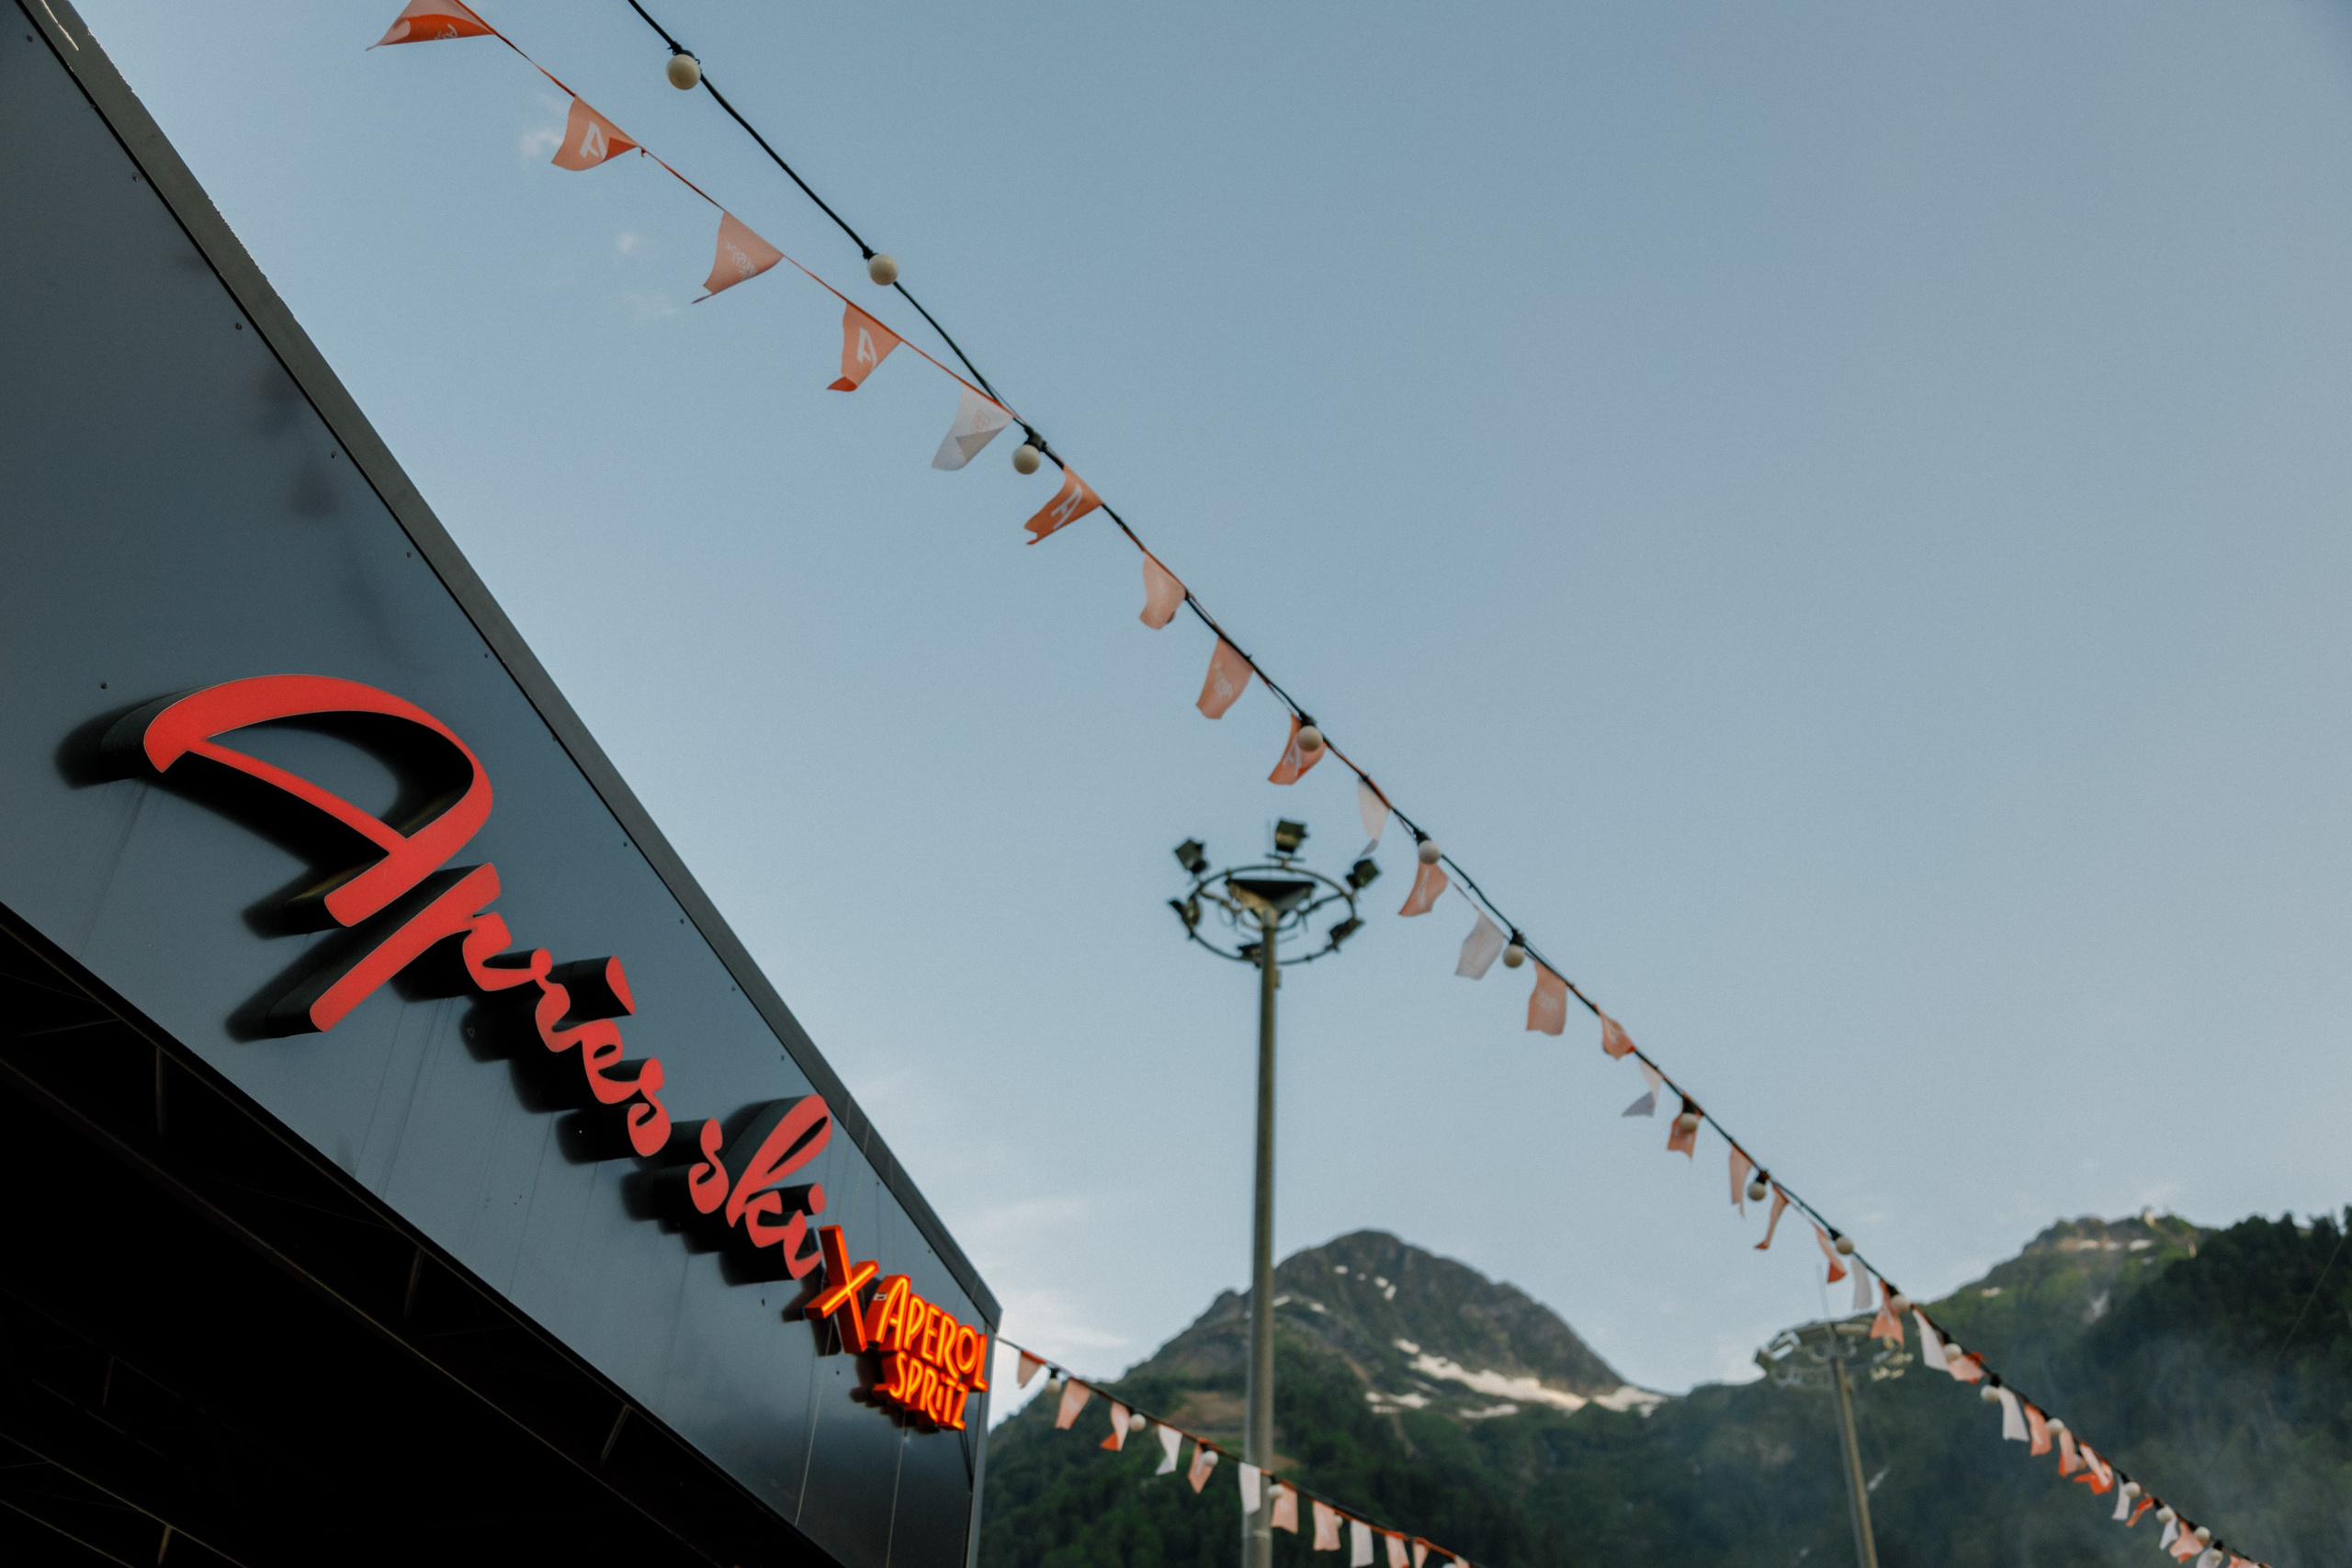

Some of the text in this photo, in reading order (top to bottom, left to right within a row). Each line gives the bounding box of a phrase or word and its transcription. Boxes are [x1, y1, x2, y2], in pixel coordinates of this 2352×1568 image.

[688, 1094, 832, 1280] ski
[810, 1224, 879, 1354] X
[870, 1274, 988, 1392] APEROL
